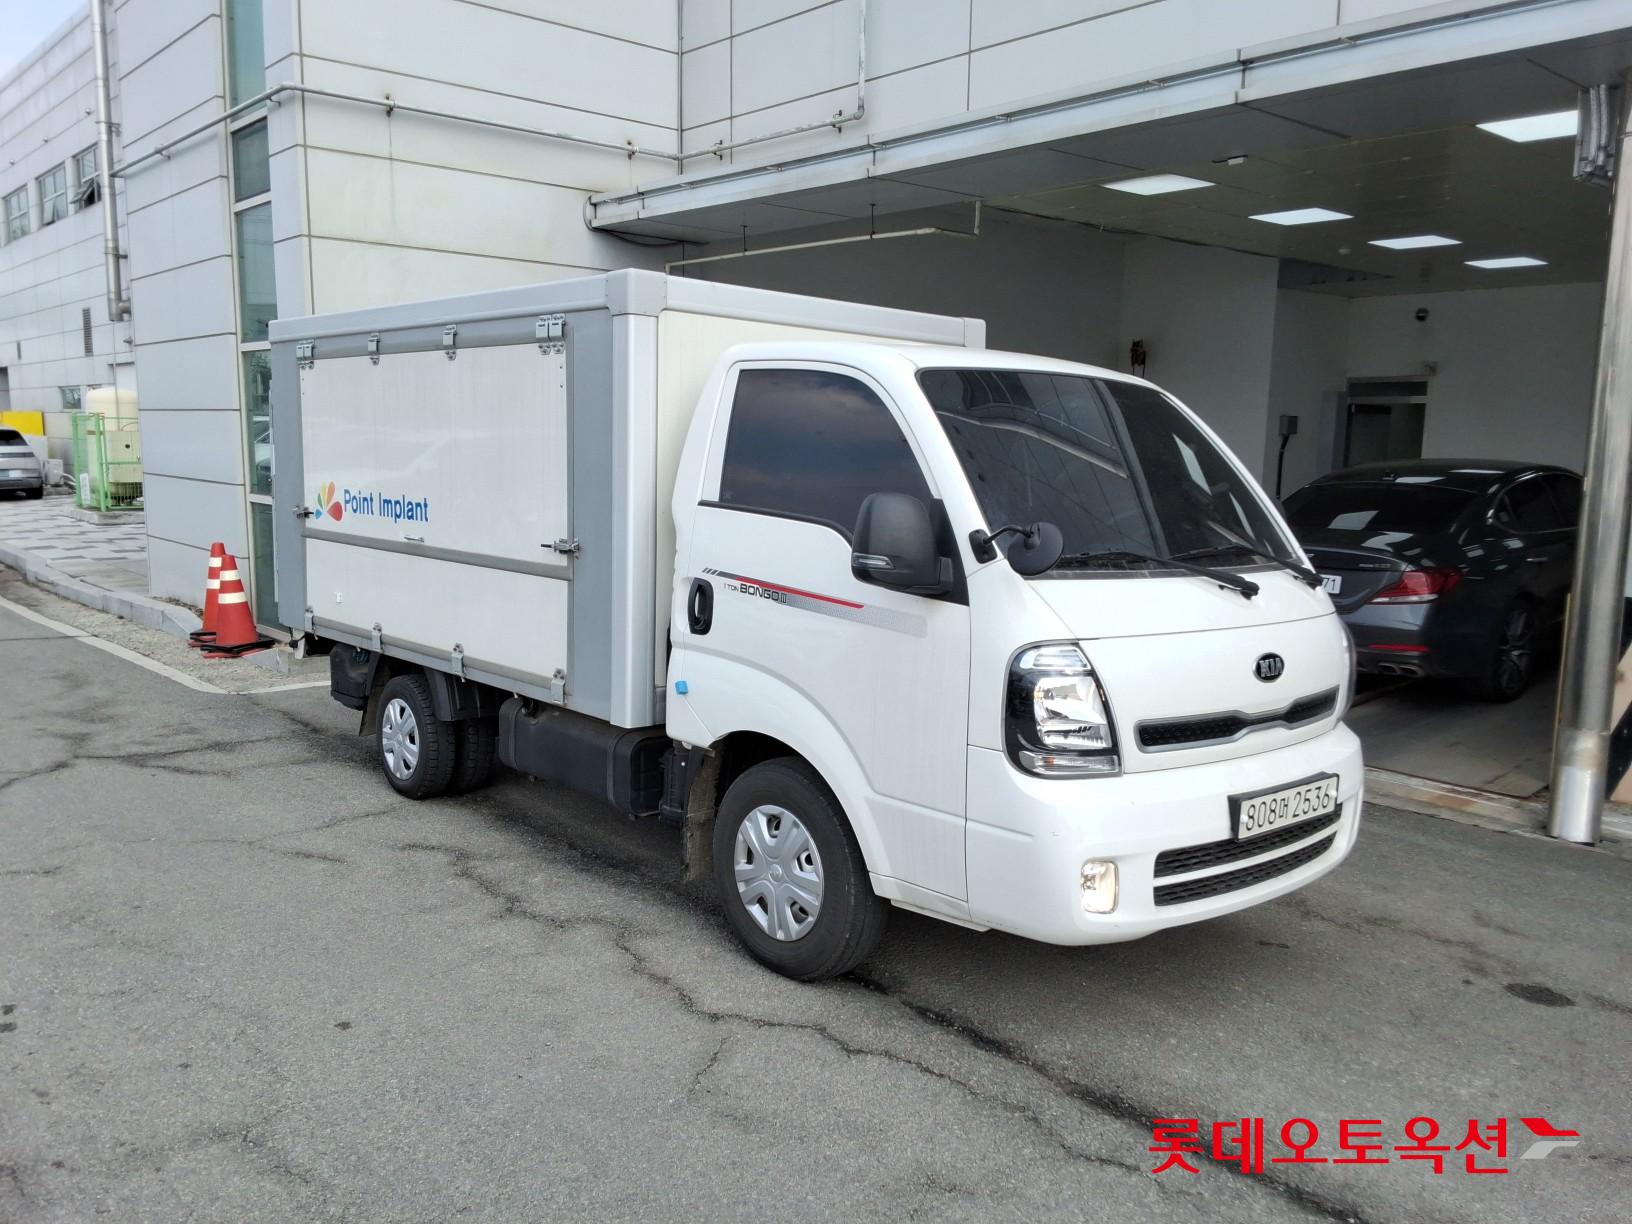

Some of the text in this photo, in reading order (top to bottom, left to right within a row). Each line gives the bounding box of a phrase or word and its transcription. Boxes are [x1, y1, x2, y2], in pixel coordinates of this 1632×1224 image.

[344, 489, 428, 523] Point Implant
[1259, 657, 1283, 677] KIA
